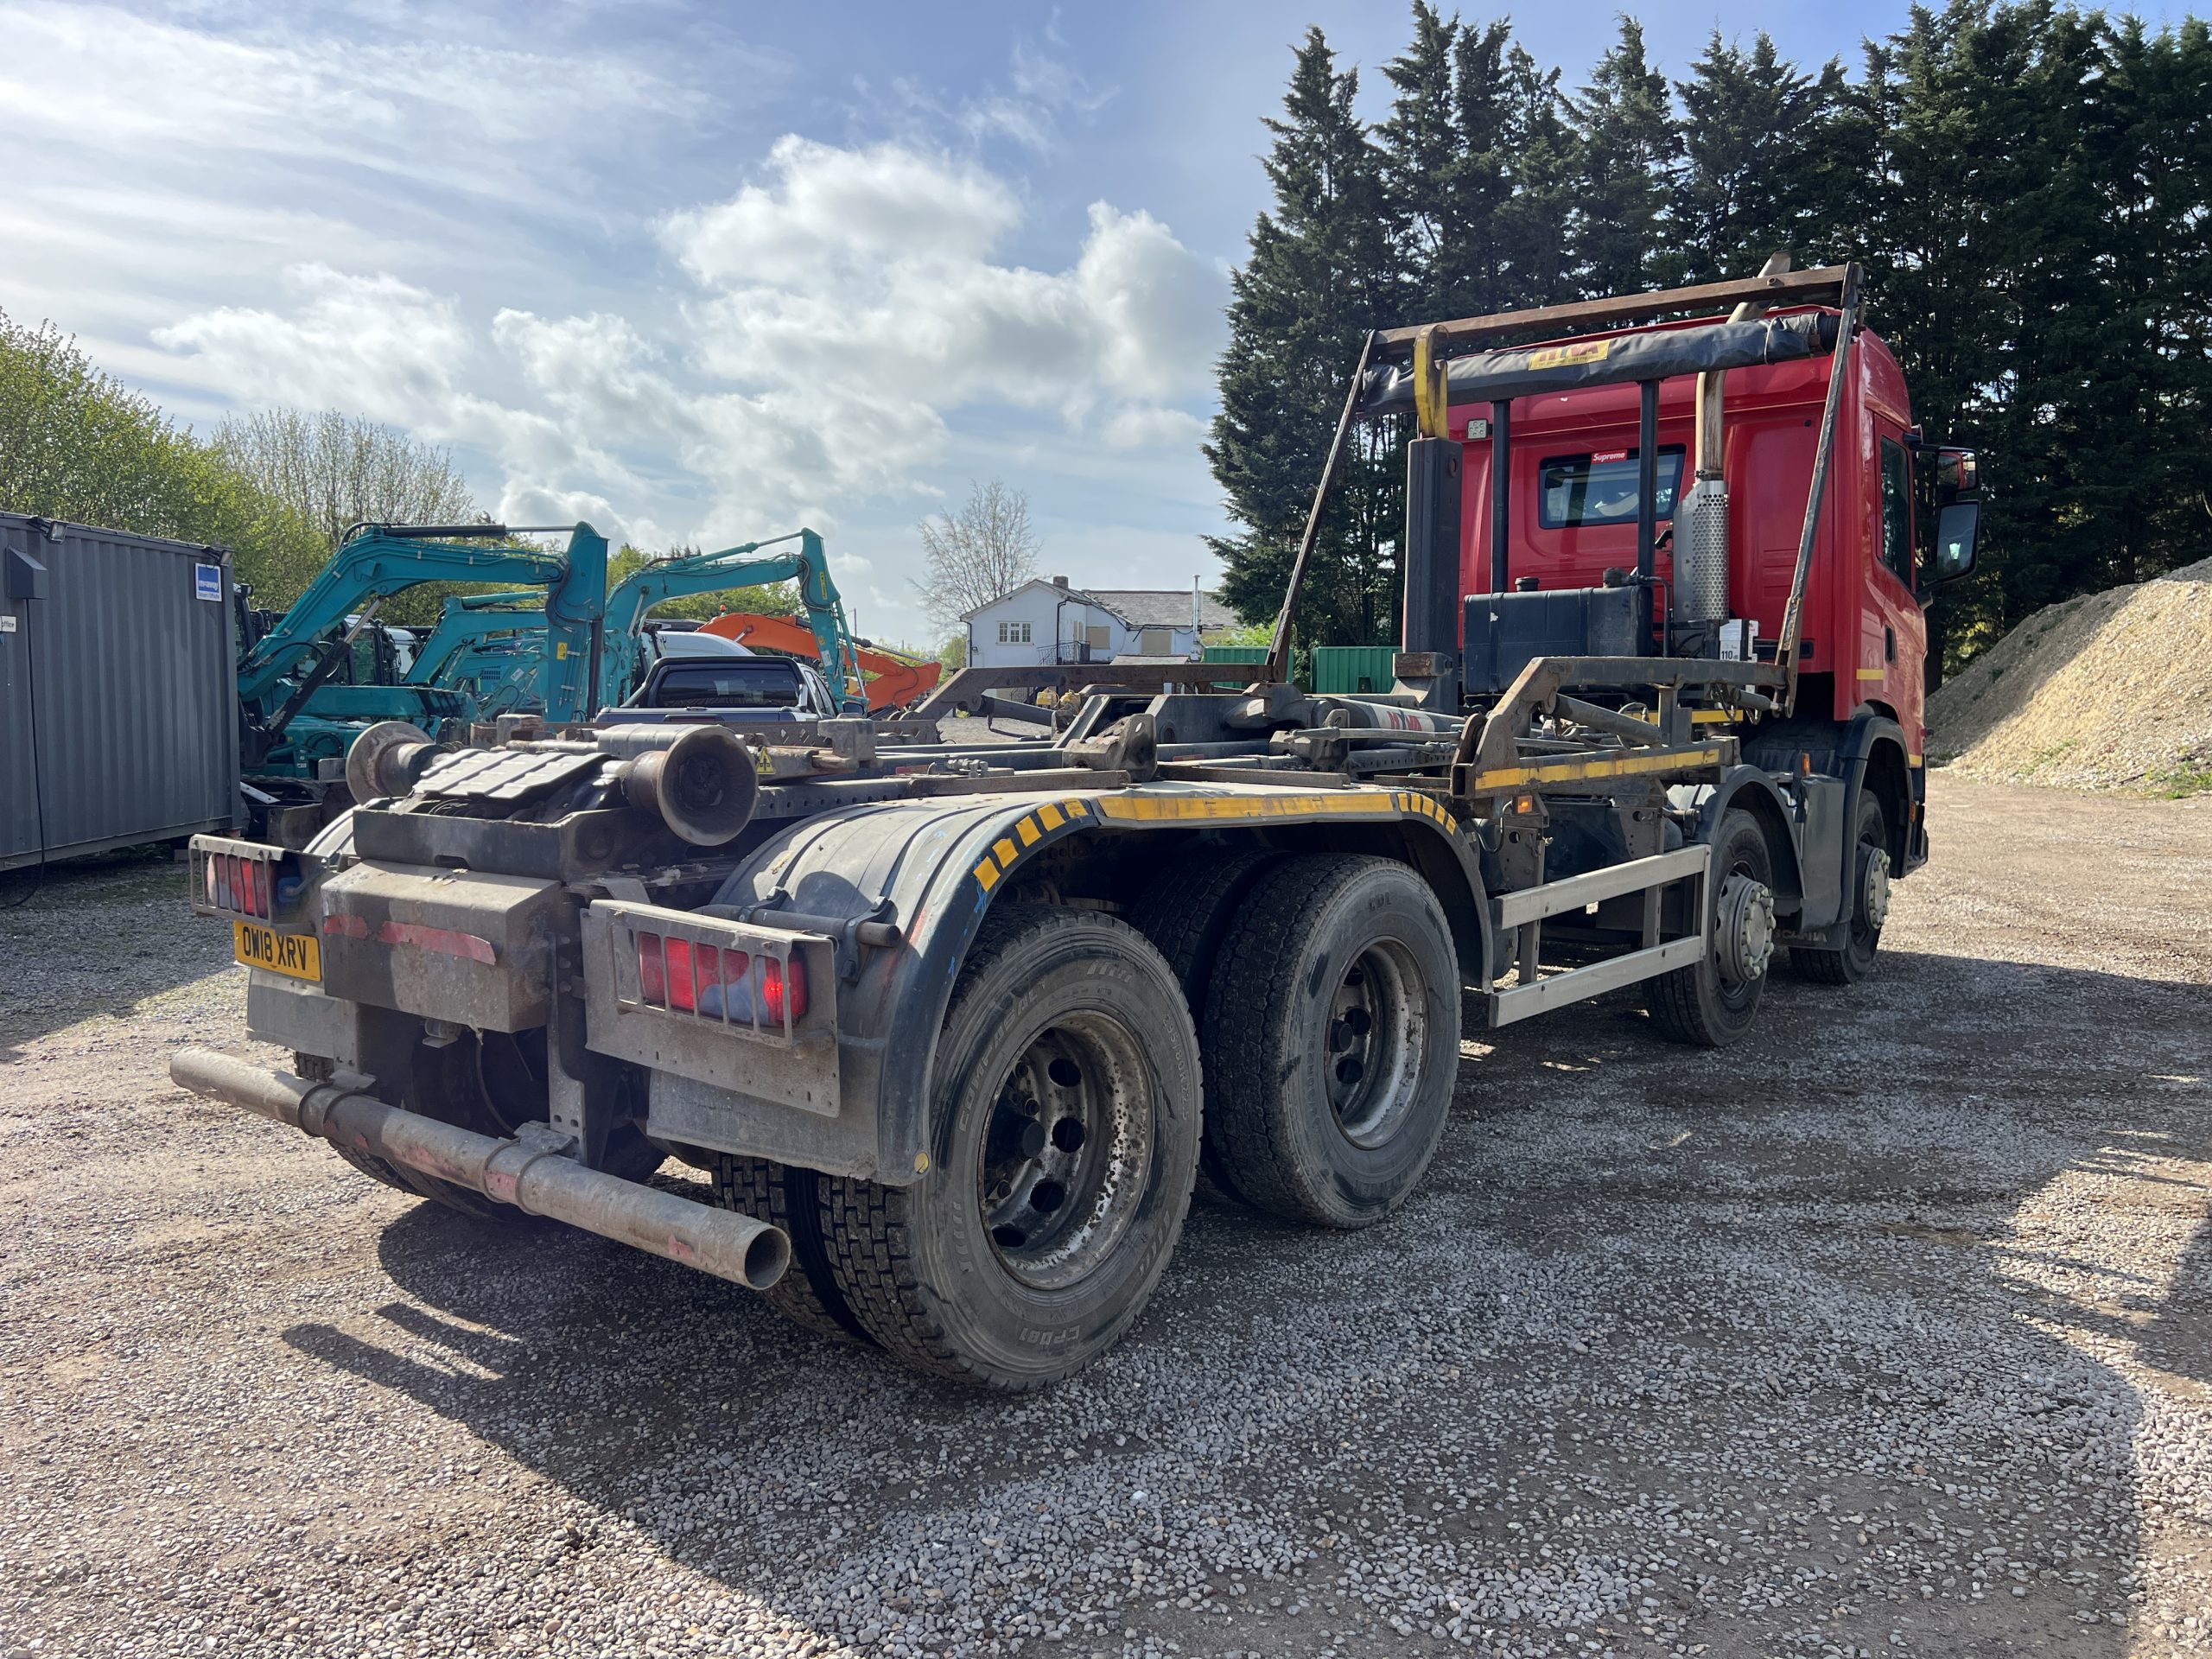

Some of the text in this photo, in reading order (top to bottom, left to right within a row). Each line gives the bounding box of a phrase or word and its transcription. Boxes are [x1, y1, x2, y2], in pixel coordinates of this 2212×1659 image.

[1592, 452, 1625, 462] Supreme
[1721, 650, 1733, 660] 110
[243, 925, 307, 970] OW18 XRV
